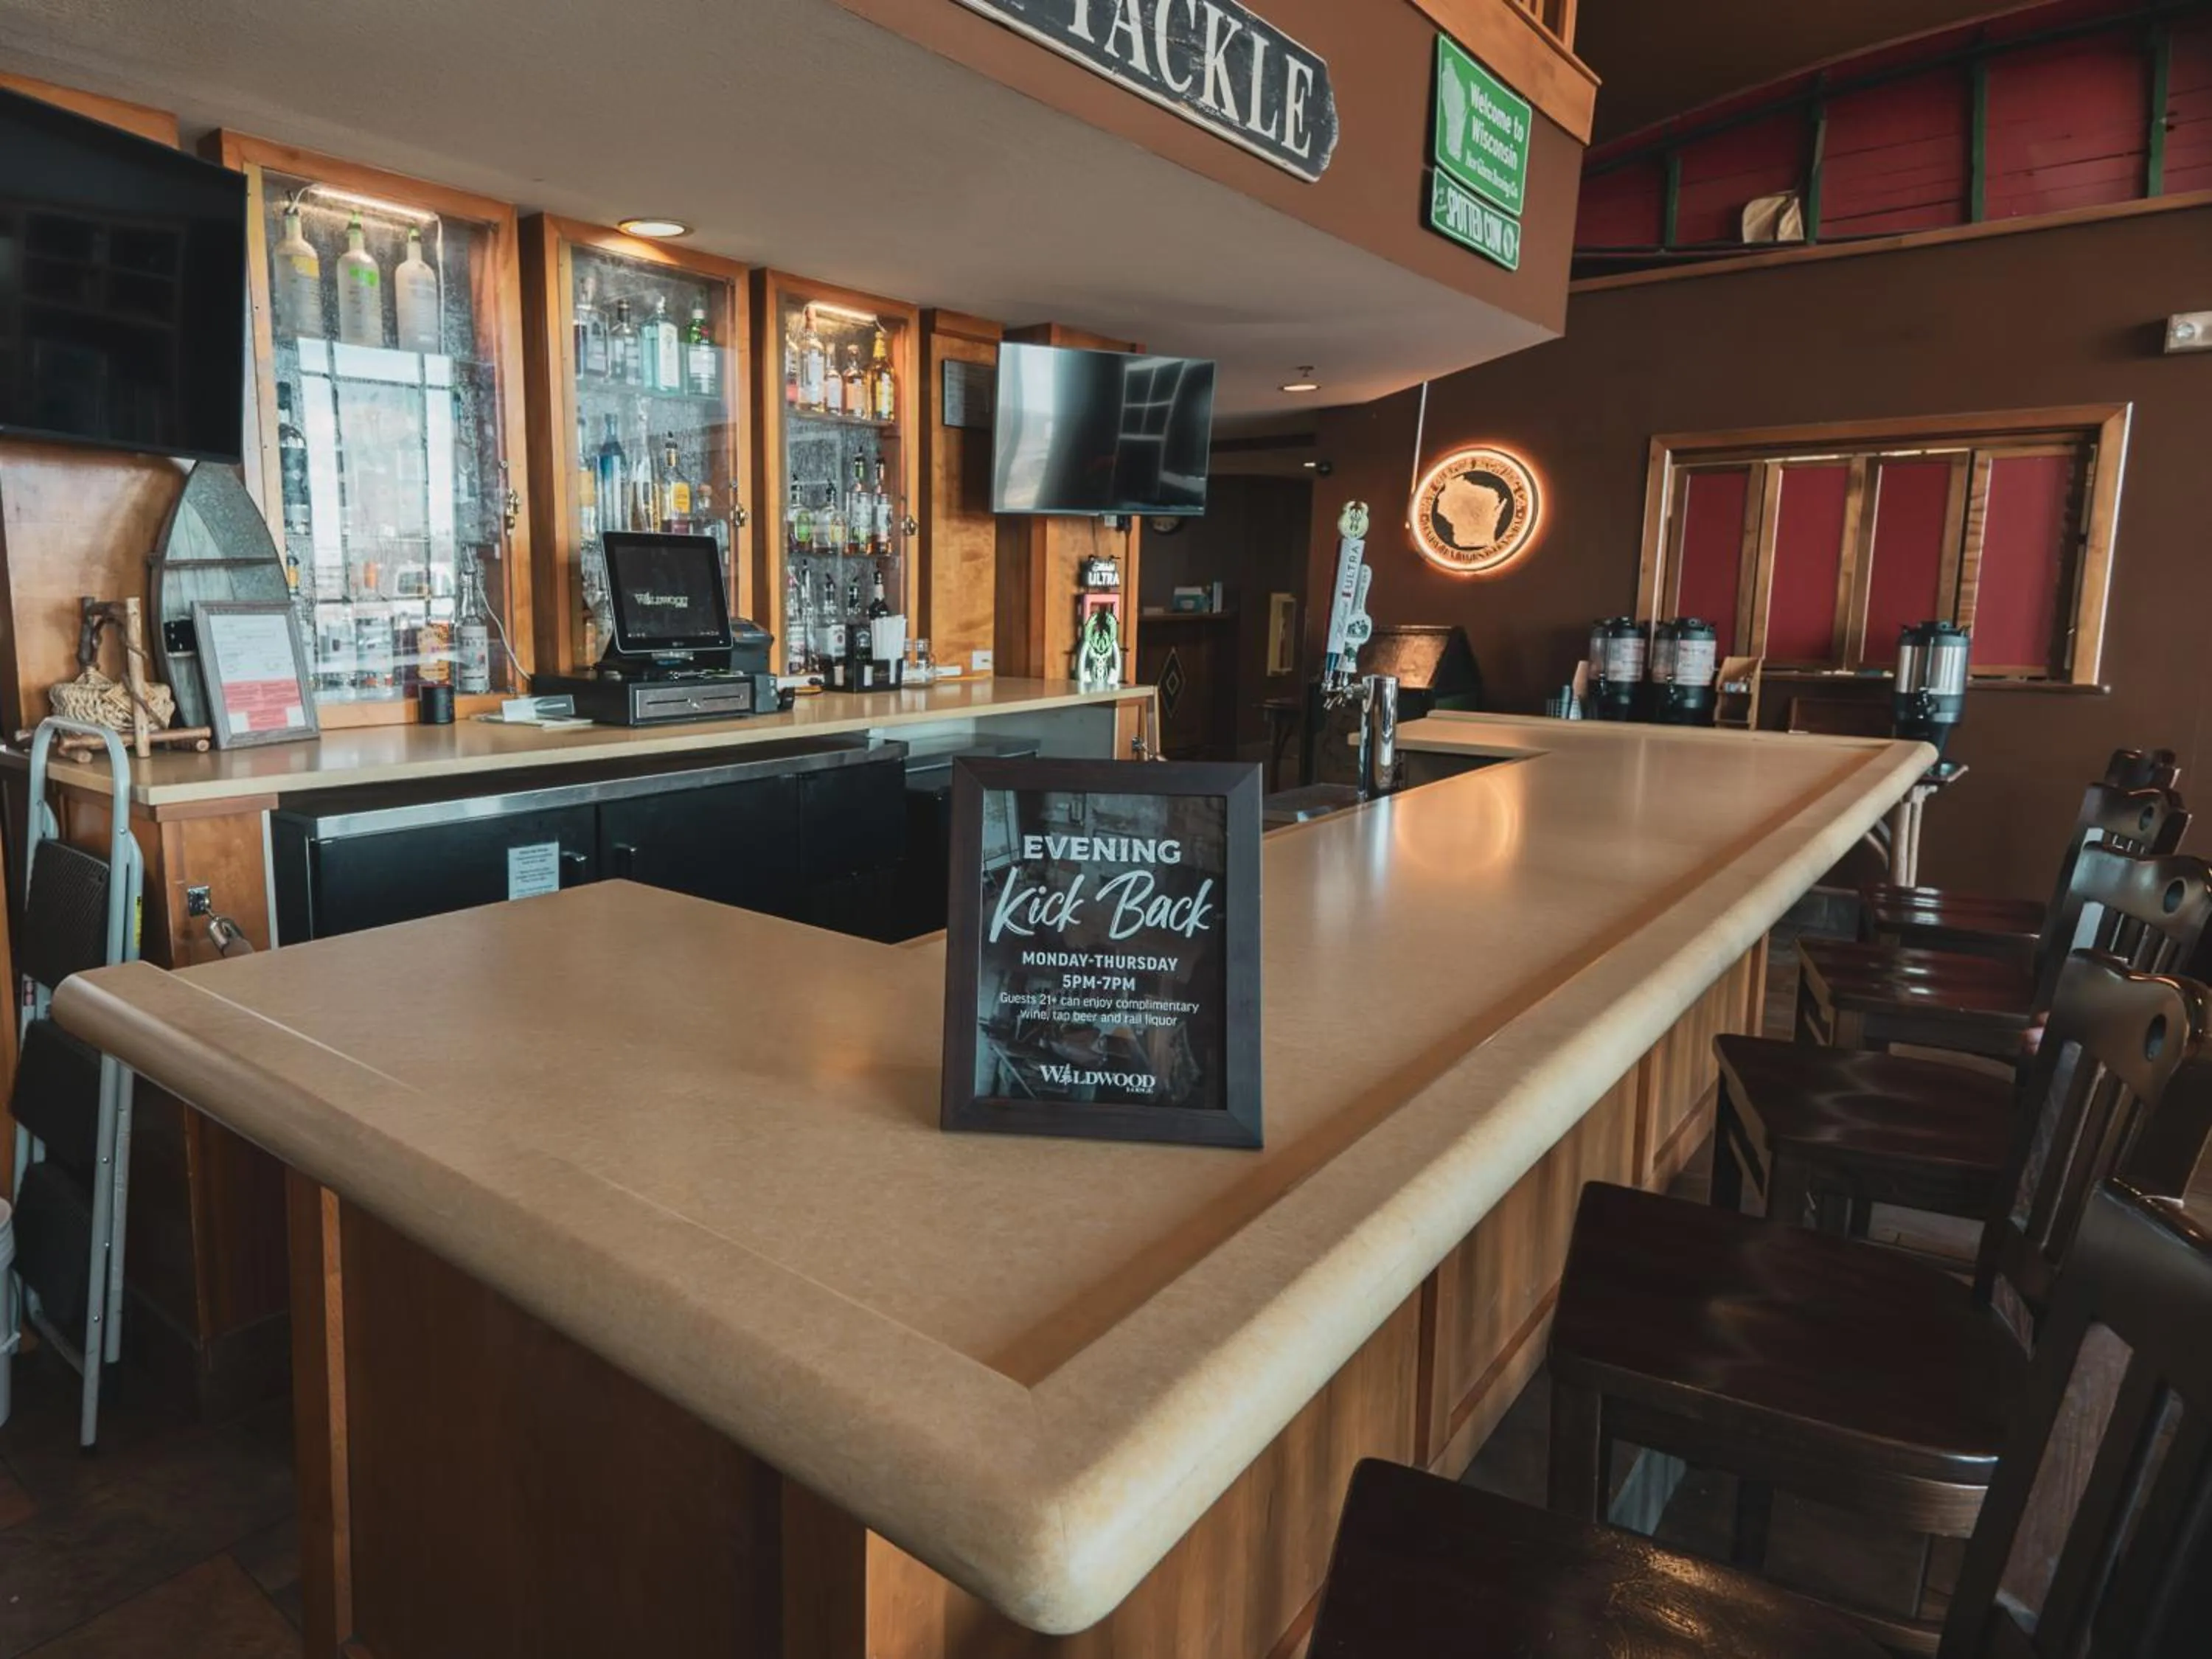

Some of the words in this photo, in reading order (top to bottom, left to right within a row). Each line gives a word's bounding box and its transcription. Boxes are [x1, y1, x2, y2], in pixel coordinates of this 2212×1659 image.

[1470, 80, 1512, 134] Welcome
[1514, 115, 1524, 143] to
[1472, 115, 1518, 171] Wisconsin
[1088, 571, 1120, 585] ULTRA
[1345, 545, 1360, 588] ULTRA
[1023, 834, 1181, 864] EVENING
[989, 866, 1085, 943] Kick
[1095, 869, 1214, 941] Back
[1022, 951, 1178, 972] MONDAY-THURSDAY
[1062, 974, 1135, 991] 5PM-7PM
[1000, 992, 1036, 1005] Guests
[1039, 993, 1057, 1006] 21+
[1060, 995, 1080, 1007] can
[1083, 996, 1112, 1010] enjoy
[1116, 998, 1200, 1015] complimentary
[1052, 1011, 1070, 1023] tap
[1073, 1011, 1096, 1022] beer
[1100, 1012, 1121, 1023] and
[1144, 1013, 1178, 1027] liquor
